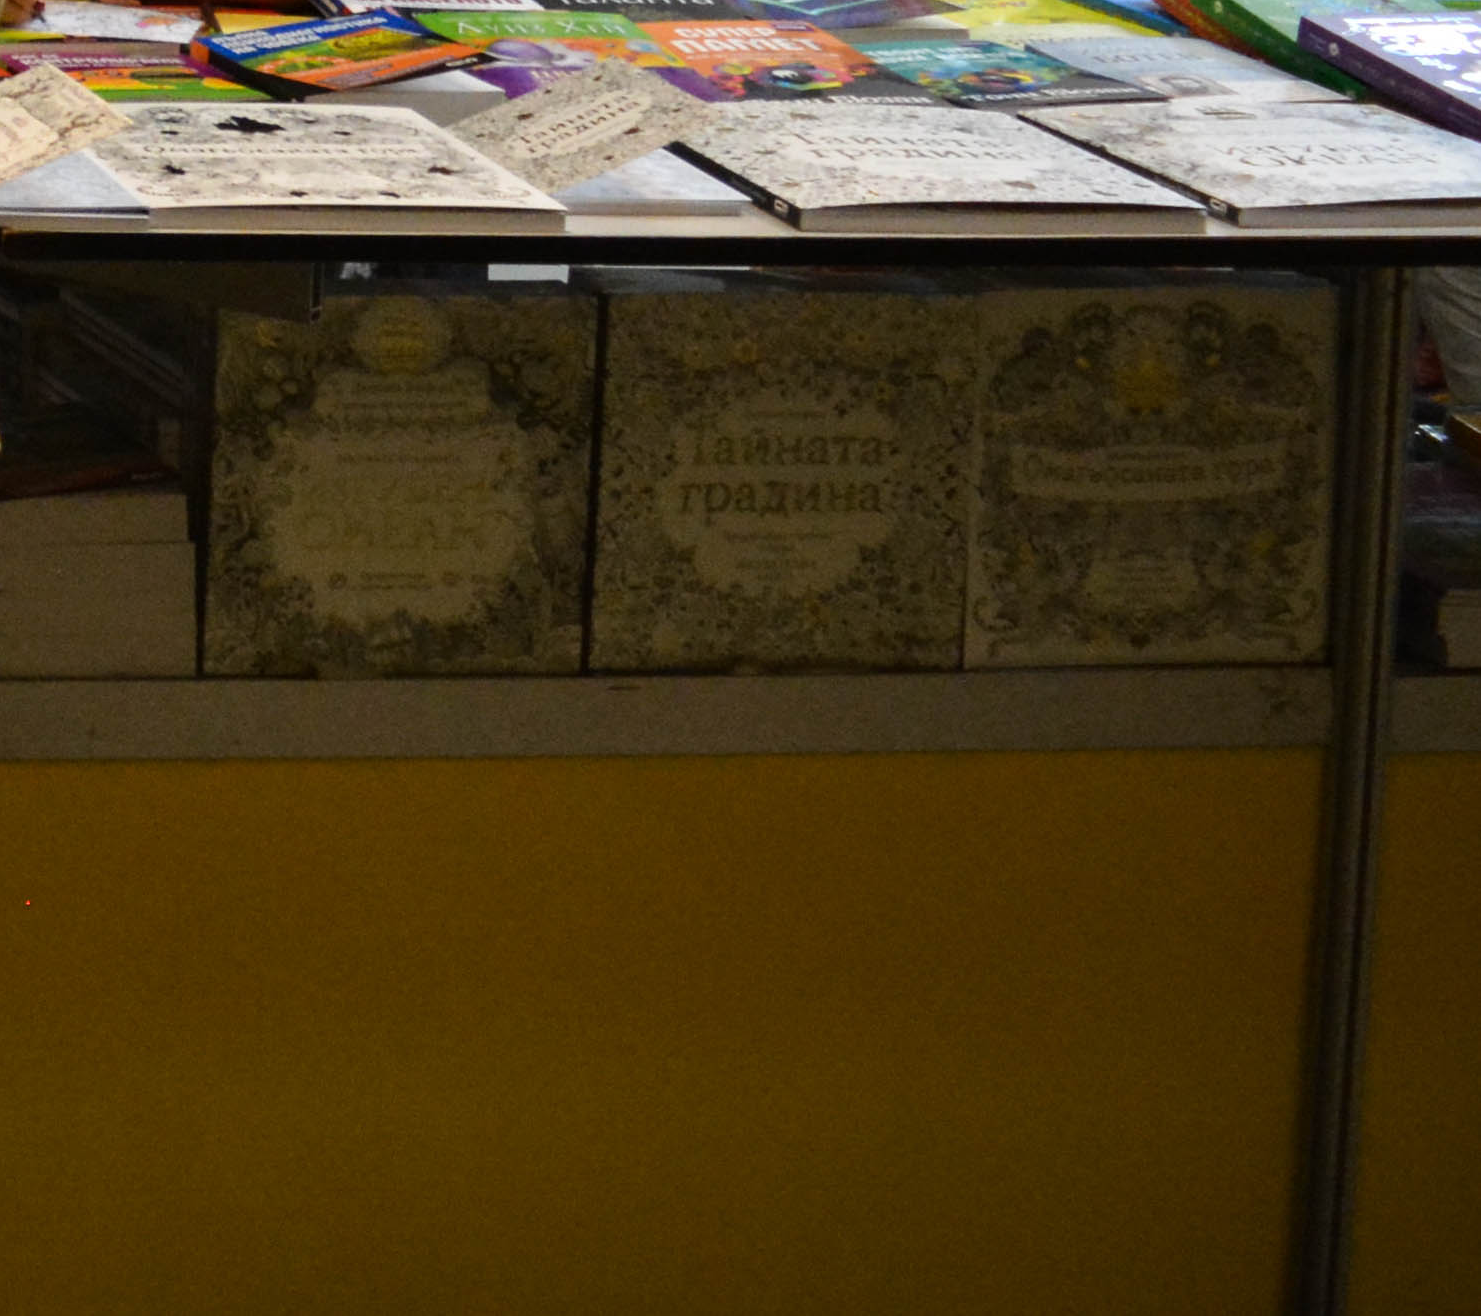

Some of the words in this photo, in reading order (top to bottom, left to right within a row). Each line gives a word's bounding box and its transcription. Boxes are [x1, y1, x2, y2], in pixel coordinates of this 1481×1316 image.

[674, 26, 777, 39] СУПЕР
[670, 38, 823, 54] ПАМЕТ
[678, 480, 882, 527] градина
